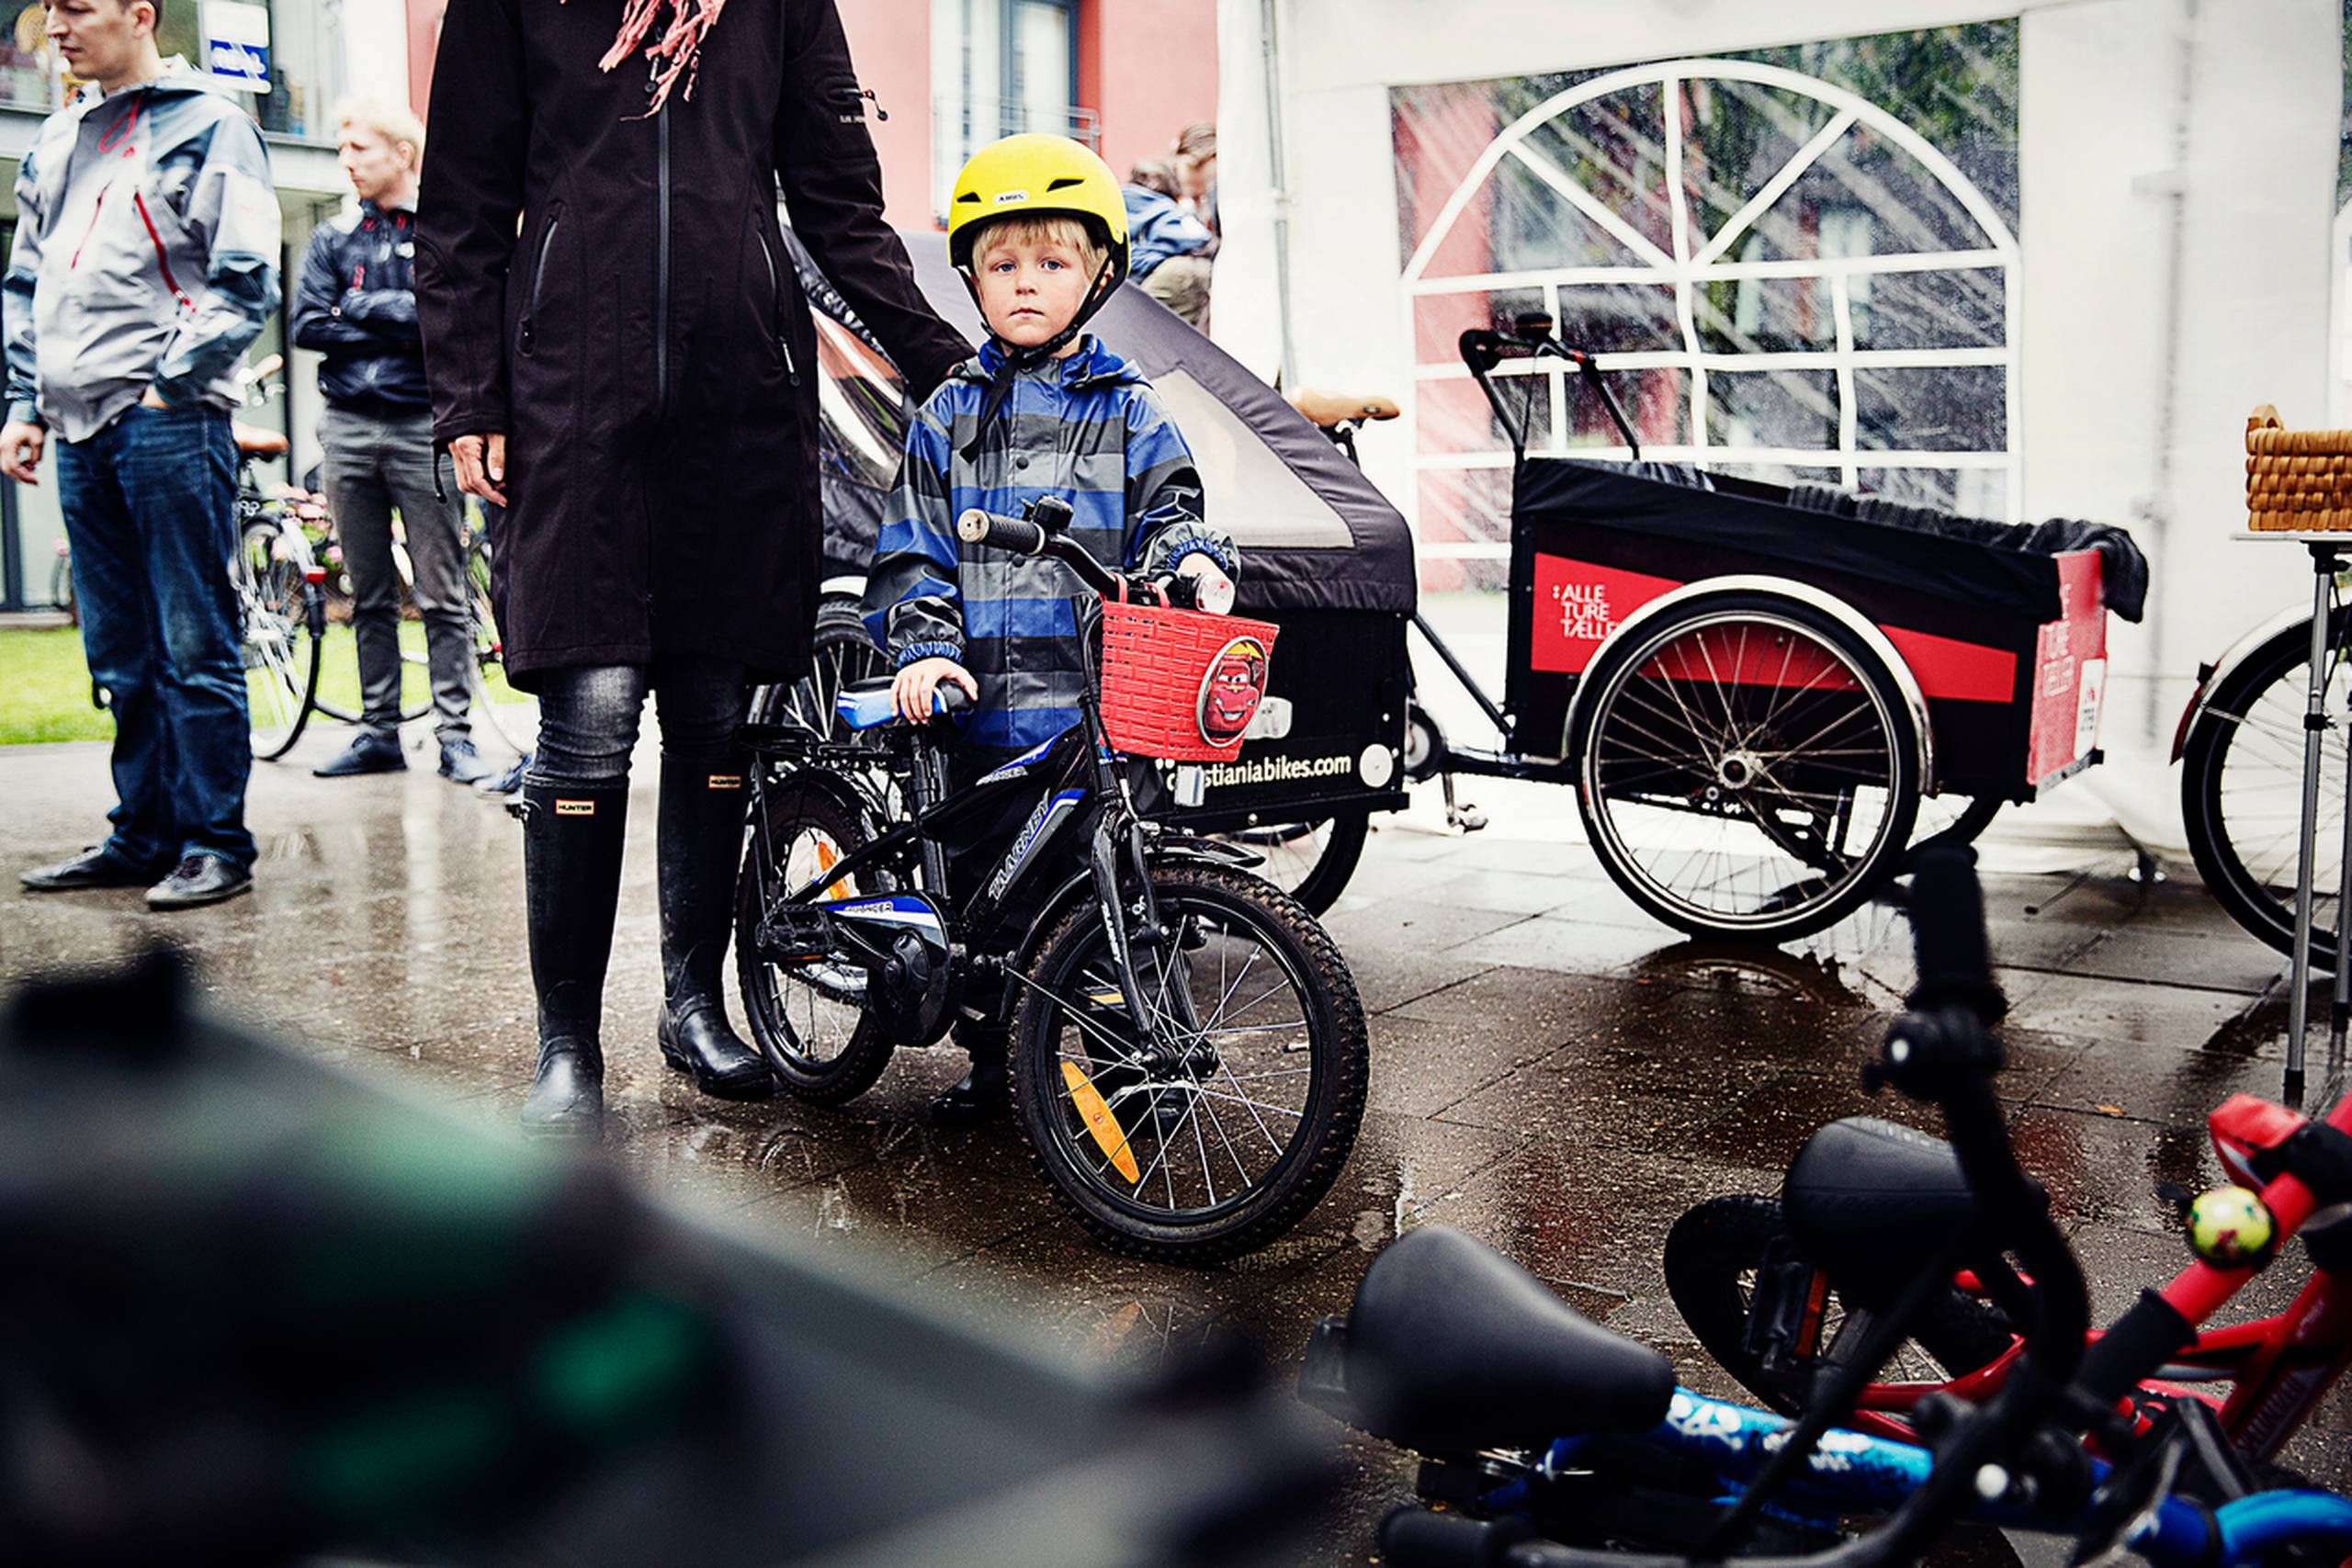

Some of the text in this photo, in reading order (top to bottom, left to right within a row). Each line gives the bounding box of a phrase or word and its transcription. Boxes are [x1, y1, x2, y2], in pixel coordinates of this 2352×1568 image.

[1561, 602, 1610, 621] TURE
[1166, 754, 1351, 792] cstianiabikes.com
[558, 802, 593, 813] HUNTER
